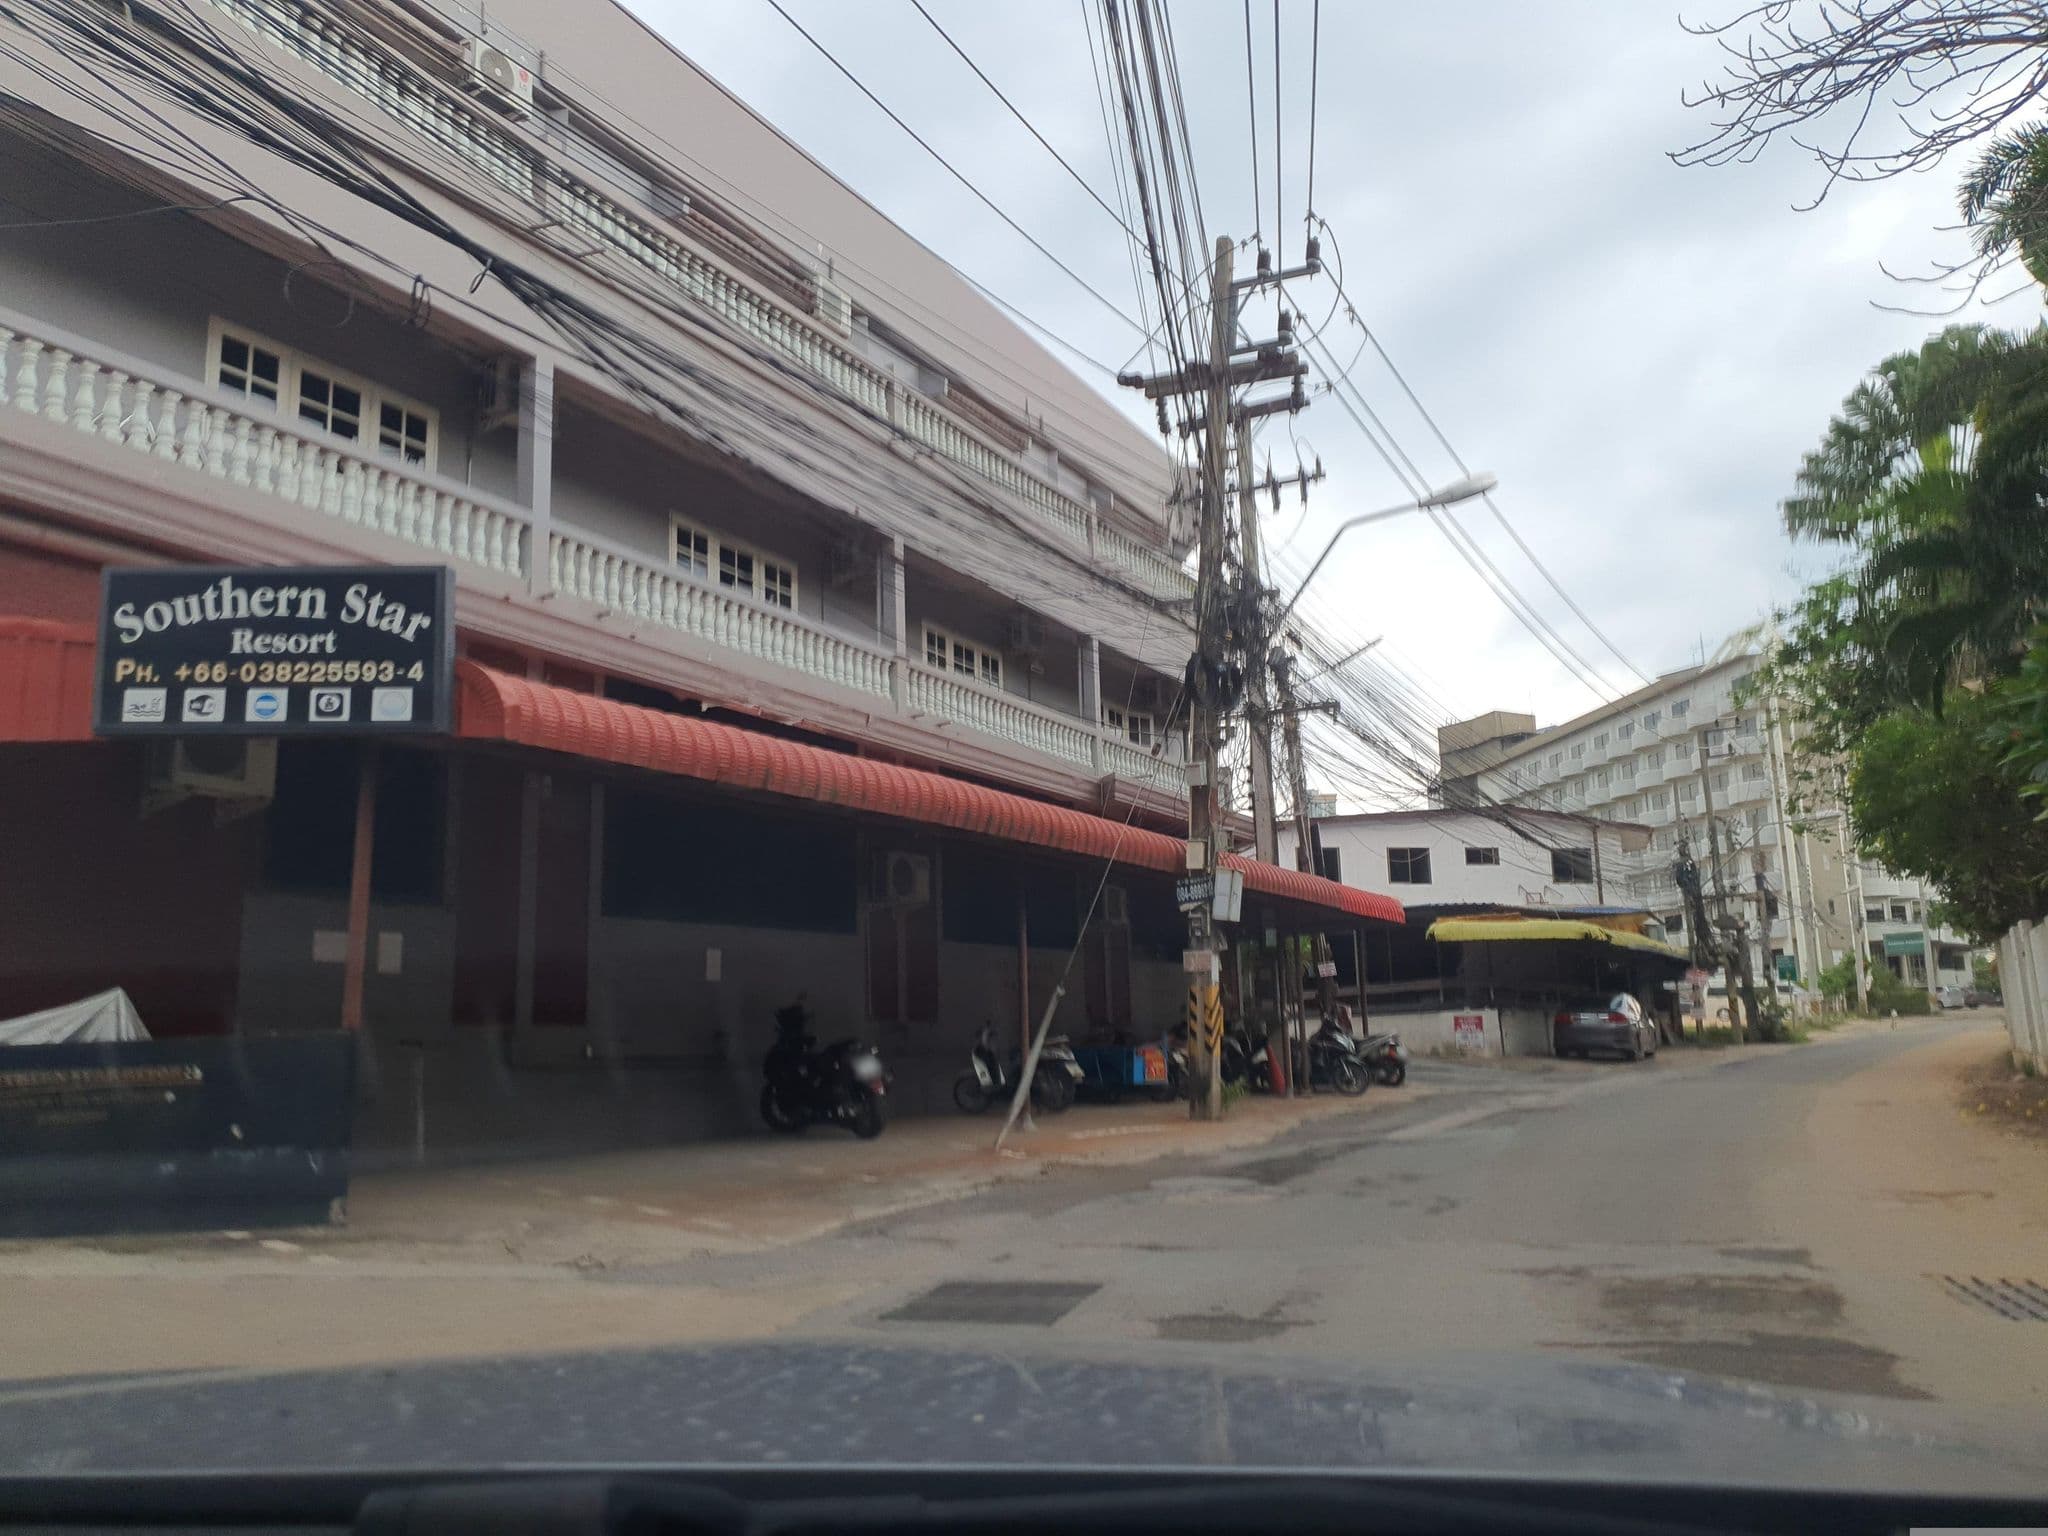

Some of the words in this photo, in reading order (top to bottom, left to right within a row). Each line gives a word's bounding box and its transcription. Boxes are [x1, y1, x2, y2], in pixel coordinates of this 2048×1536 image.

[113, 576, 328, 644] Southern
[340, 582, 431, 643] Star
[230, 628, 337, 654] Resort
[174, 660, 425, 683] +66-038225593-4
